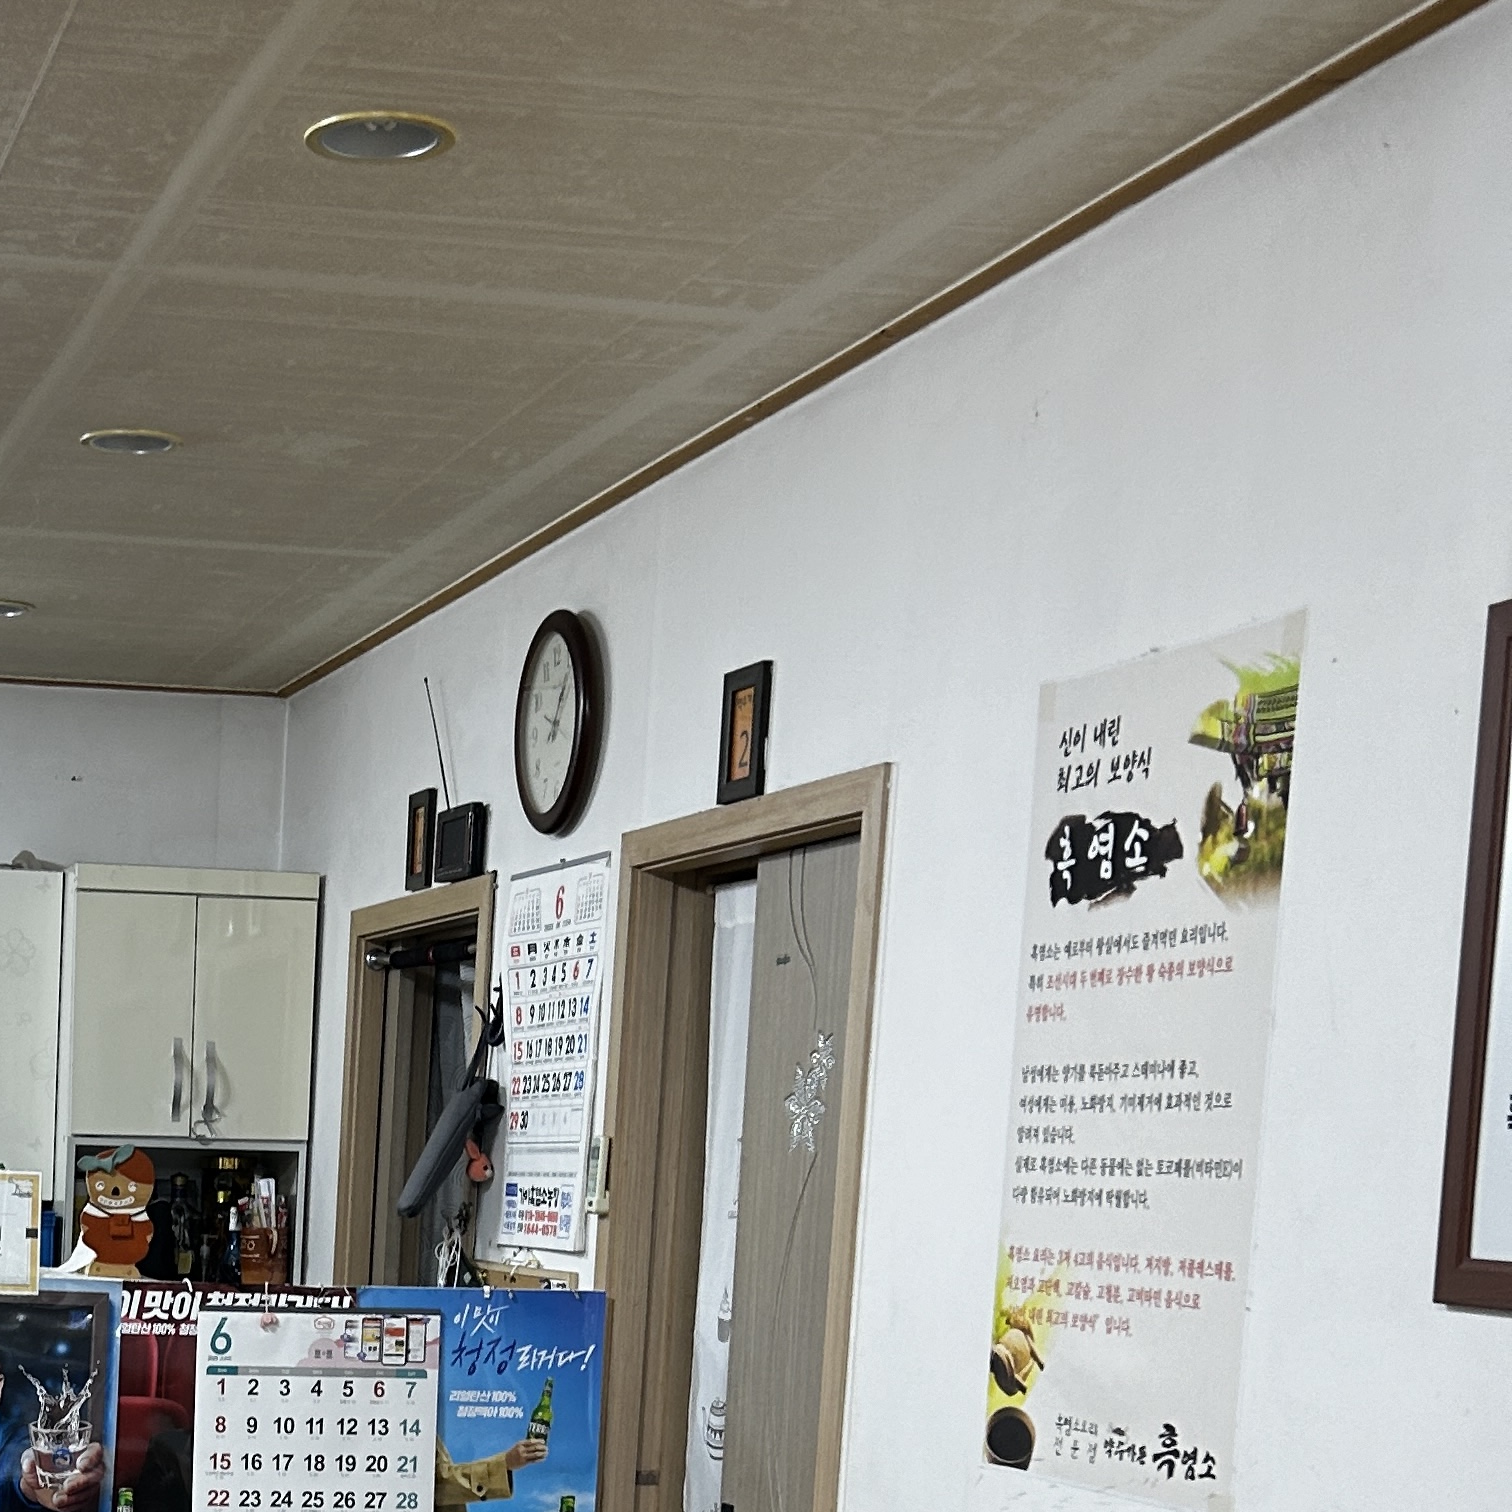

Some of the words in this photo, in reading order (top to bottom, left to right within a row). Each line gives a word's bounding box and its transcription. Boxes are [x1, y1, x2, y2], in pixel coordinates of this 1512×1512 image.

[737, 730, 749, 768] 2
[1059, 724, 1087, 756] 신이
[1093, 715, 1122, 747] 내린
[1057, 759, 1102, 793] 최고의
[1108, 747, 1152, 784] 보양식
[1057, 819, 1150, 890] 흑염소
[555, 885, 565, 920] 6
[1180, 920, 1229, 944] 요리입니다.
[515, 971, 520, 991] 1
[529, 968, 536, 989] 2
[542, 966, 548, 986] 3
[551, 964, 557, 984] 4
[561, 962, 567, 982] 5
[573, 960, 579, 980] 6
[586, 958, 594, 979] 7
[1187, 955, 1233, 978] 보양식으로
[515, 1006, 522, 1026] 8
[529, 1004, 535, 1024] 9
[538, 1002, 546, 1022] 10
[547, 1001, 556, 1021] 11
[557, 999, 566, 1020] 12
[568, 997, 577, 1017] 13
[579, 995, 590, 1017] 14
[513, 1041, 523, 1061] 15
[526, 1039, 533, 1060] 16
[535, 1038, 543, 1058] 17
[544, 1037, 553, 1057] 18
[554, 1036, 563, 1056] 19
[565, 1034, 576, 1055] 20
[577, 1033, 587, 1054] 21
[511, 1076, 521, 1096] 22
[522, 1074, 532, 1095] 23
[532, 1074, 540, 1094] 24
[541, 1073, 551, 1093] 25
[552, 1072, 561, 1092] 26
[562, 1071, 573, 1092] 27
[573, 1070, 585, 1091] 28
[1205, 1092, 1233, 1113] 것으로
[509, 1111, 519, 1131] 29
[520, 1110, 529, 1130] 30
[142, 1290, 203, 1320] 맛이
[454, 1303, 470, 1329] 이
[470, 1303, 510, 1336] 맛이
[210, 1317, 232, 1354] 6
[451, 1331, 596, 1376] 청정라거다!
[217, 1378, 226, 1395] 1
[248, 1379, 259, 1396] 2
[279, 1379, 290, 1396] 3
[311, 1380, 322, 1397] 4
[343, 1381, 354, 1397] 5
[373, 1381, 385, 1398] 6
[406, 1382, 417, 1398] 7
[215, 1416, 226, 1433] 8
[246, 1417, 258, 1434] 9
[273, 1417, 295, 1435] 10
[306, 1418, 324, 1435] 11
[337, 1418, 358, 1435] 12
[368, 1418, 389, 1436] 13
[399, 1418, 421, 1437] 14
[209, 1453, 232, 1471] 15
[240, 1453, 263, 1471] 16
[272, 1453, 294, 1471] 17
[303, 1454, 325, 1472] 18
[335, 1455, 357, 1472] 19
[365, 1455, 388, 1473] 20
[397, 1455, 418, 1473] 21
[1153, 1423, 1216, 1480] 흑염소
[207, 1490, 230, 1508] 22
[239, 1490, 262, 1508] 23
[270, 1490, 293, 1509] 24
[301, 1491, 324, 1509] 25
[333, 1491, 356, 1510] 26
[364, 1492, 387, 1510] 27
[396, 1492, 418, 1510] 28
